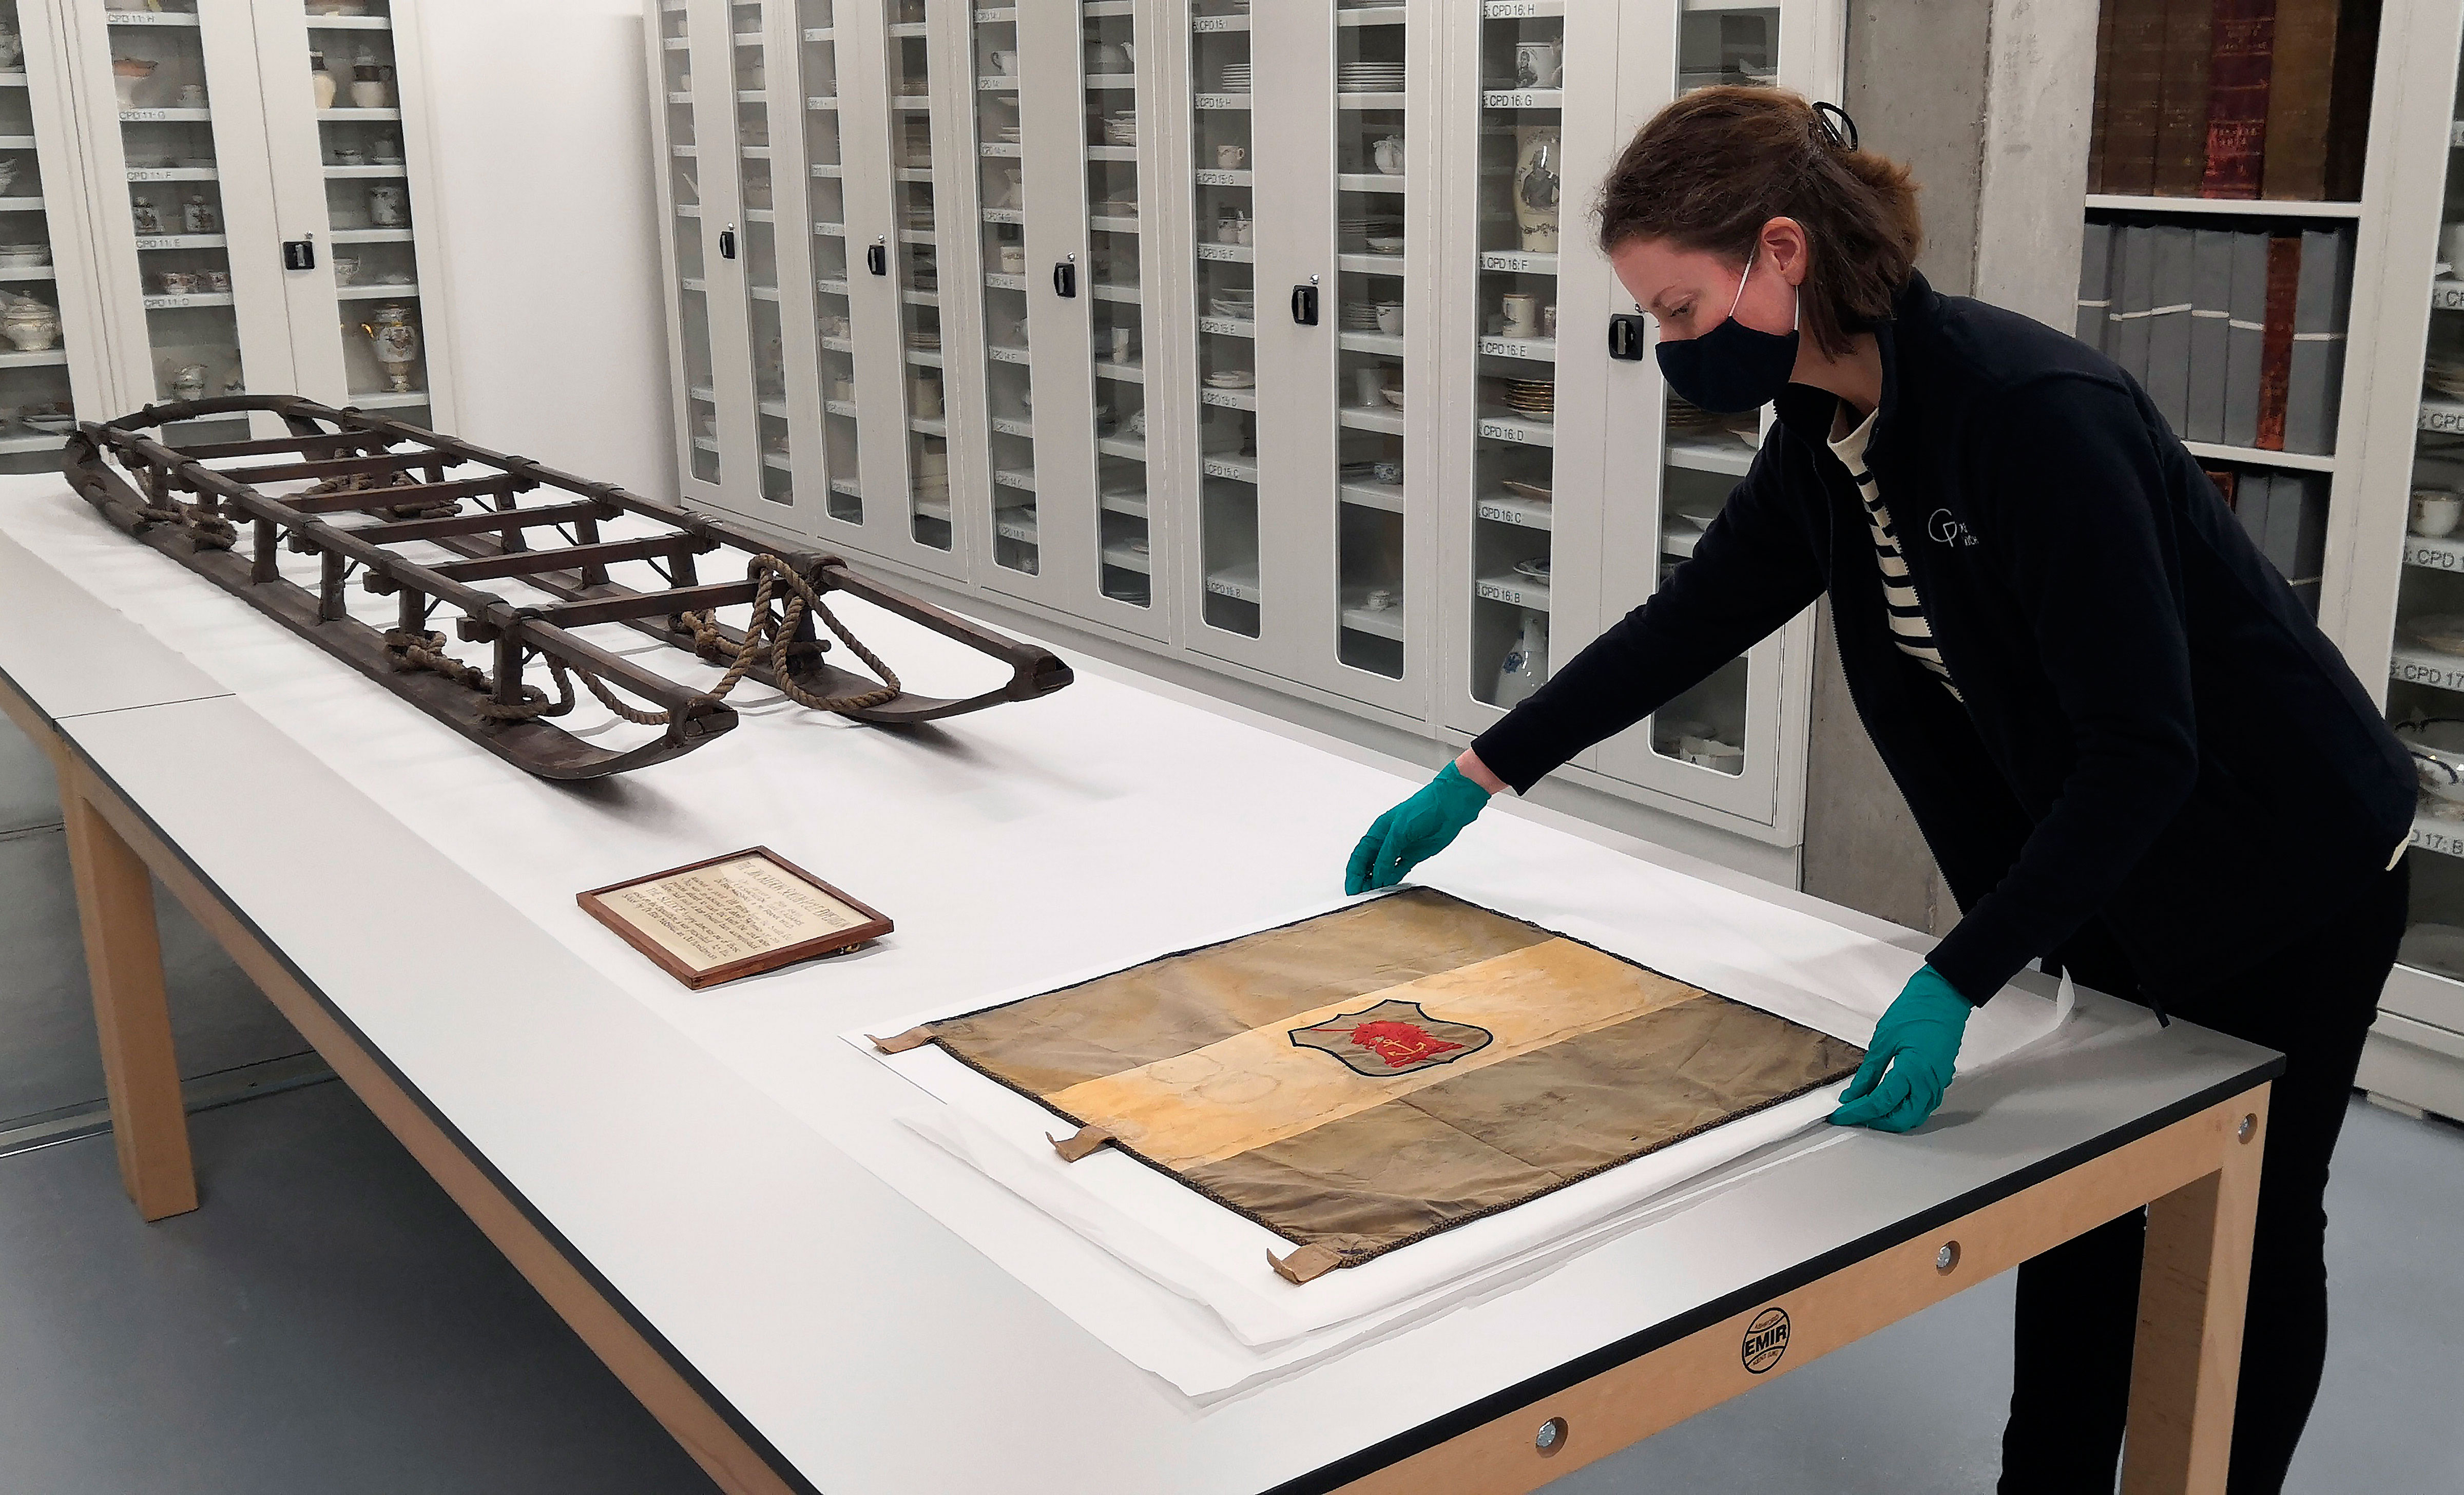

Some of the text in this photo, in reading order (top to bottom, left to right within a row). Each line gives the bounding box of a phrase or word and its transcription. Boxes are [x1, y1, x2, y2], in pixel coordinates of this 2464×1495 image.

[1492, 5, 1511, 16] CPD
[1528, 4, 1534, 15] H
[1490, 95, 1509, 106] CPD
[1526, 94, 1532, 106] G
[1487, 257, 1505, 269] CPD
[1522, 260, 1528, 270] F
[1486, 342, 1504, 354] CPD
[1520, 346, 1526, 357] E
[1484, 425, 1502, 437] CPD
[1517, 430, 1524, 441] D
[1482, 507, 1499, 519] CPD
[1515, 512, 1521, 523] C
[2418, 549, 2454, 567] CPD
[1482, 586, 1499, 598] CPD
[1514, 593, 1520, 603] B
[2404, 663, 2441, 684] CPD
[1745, 1324, 1787, 1357] EMIR
